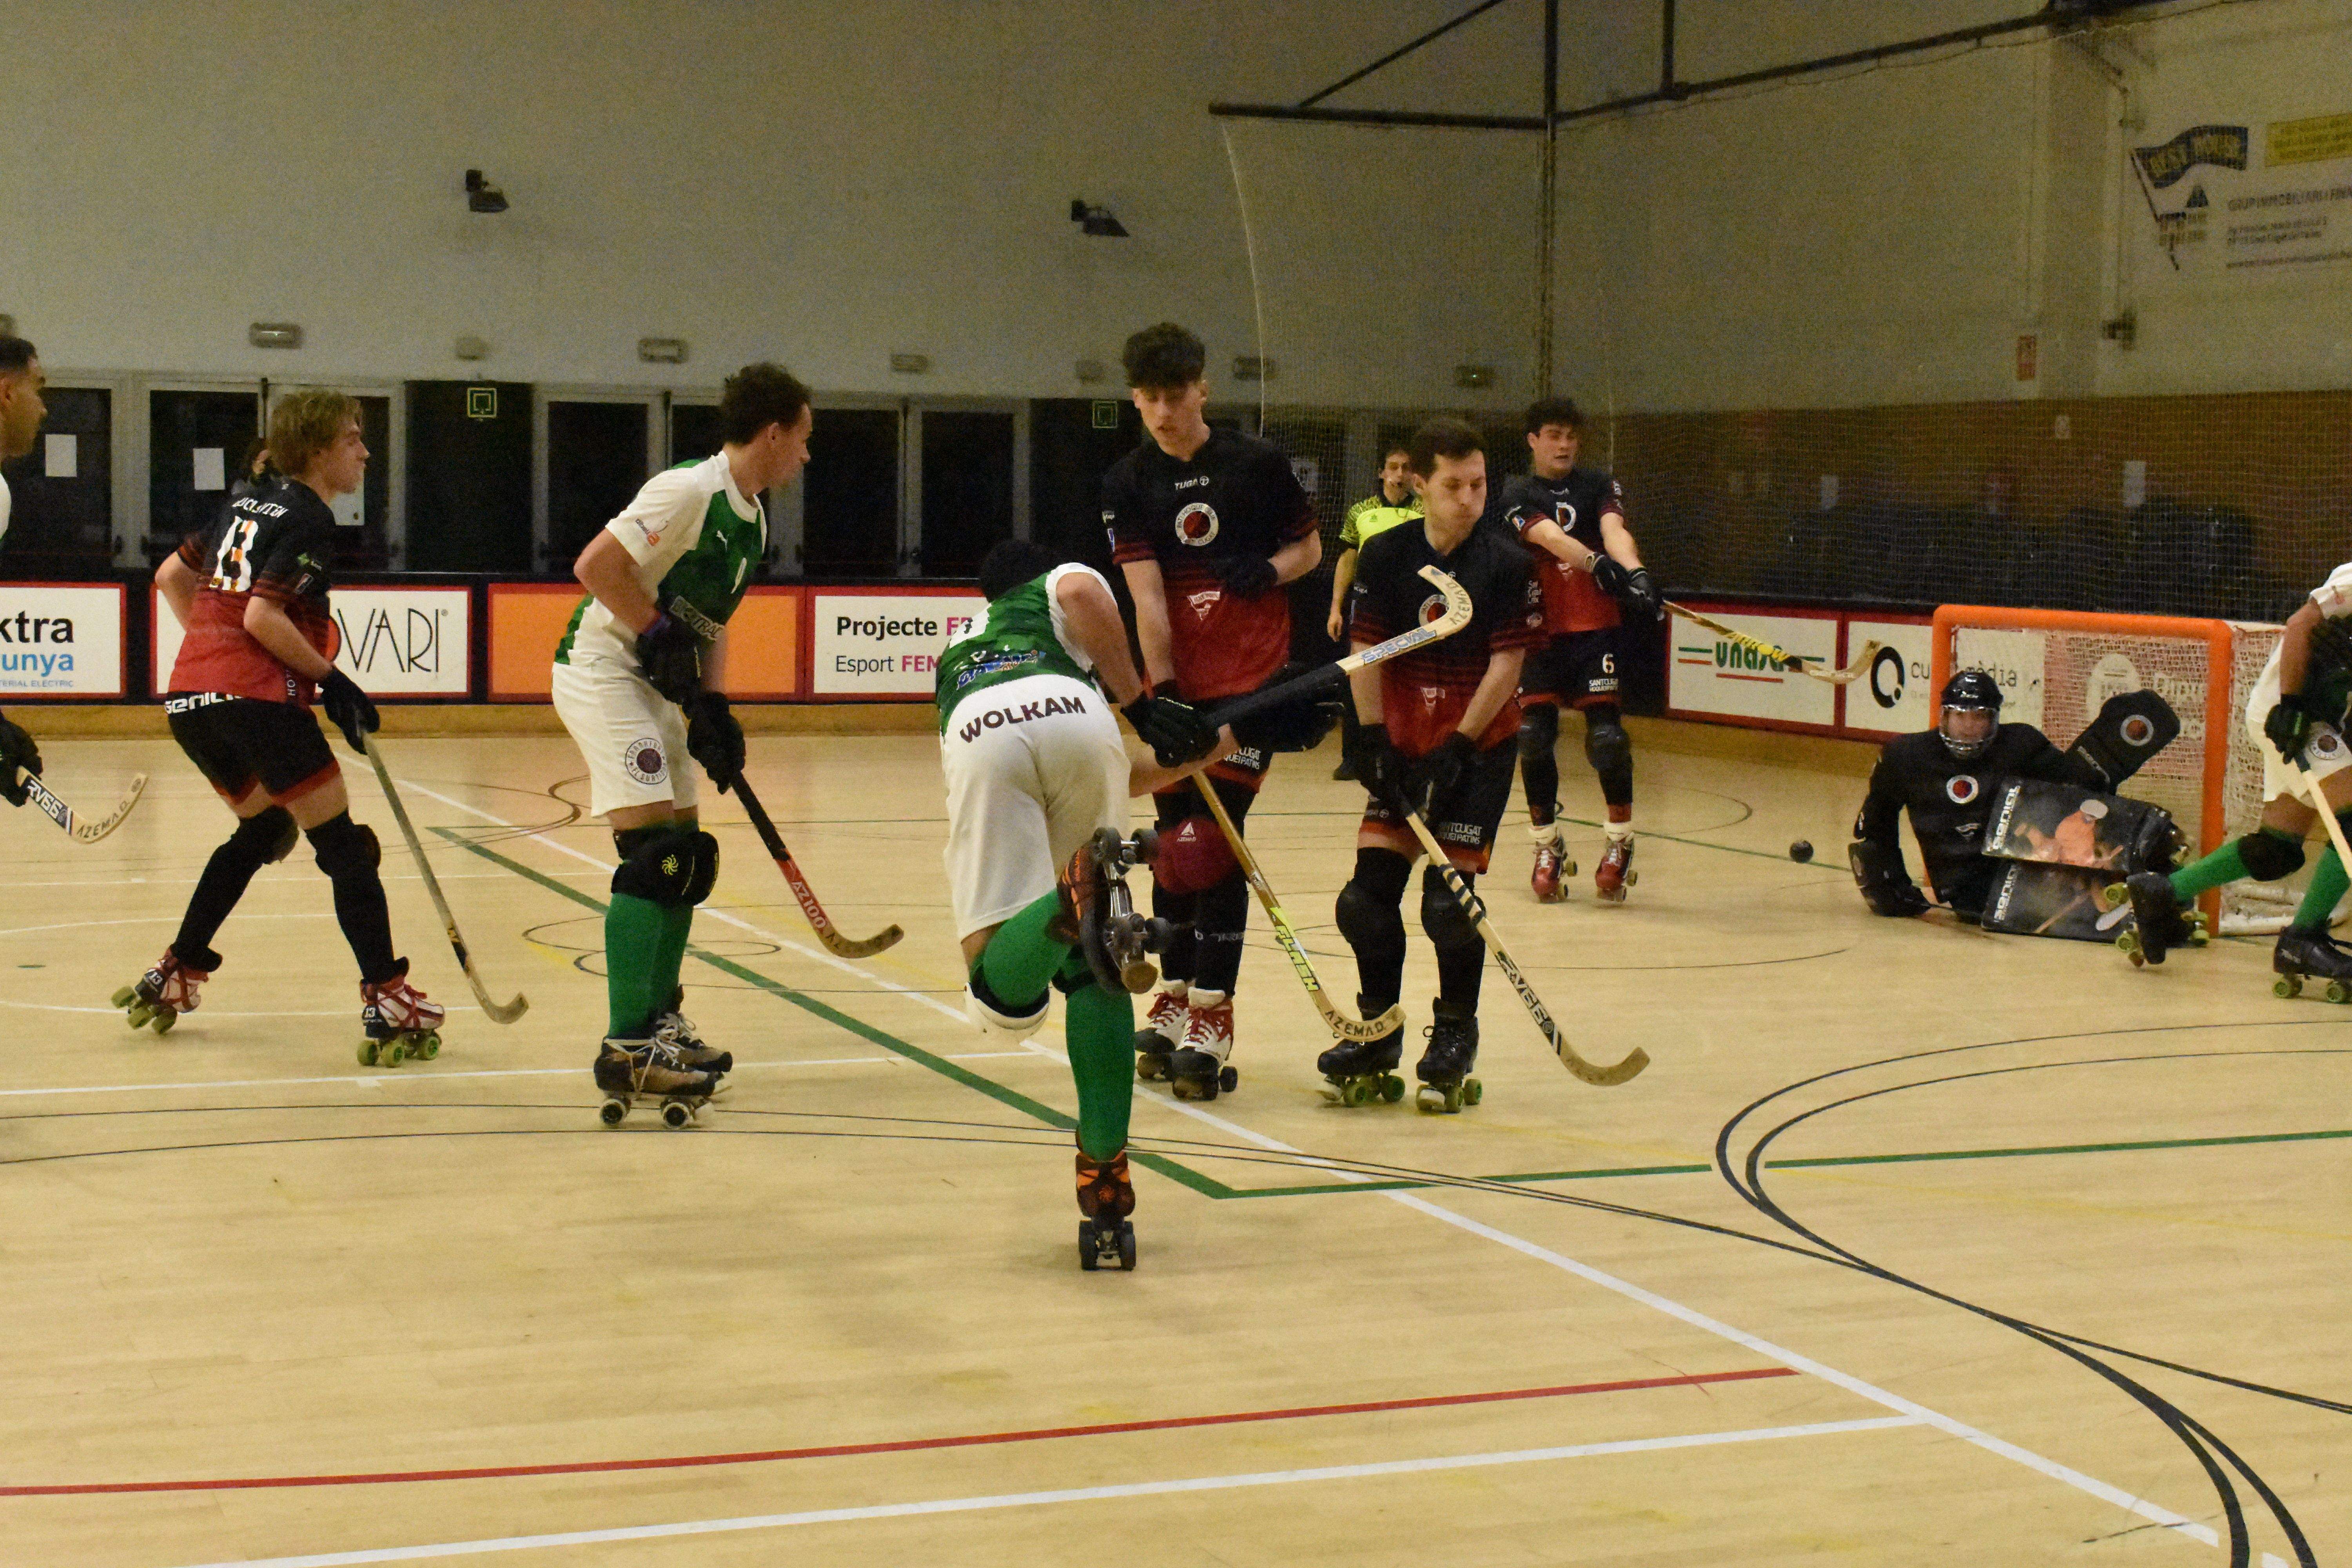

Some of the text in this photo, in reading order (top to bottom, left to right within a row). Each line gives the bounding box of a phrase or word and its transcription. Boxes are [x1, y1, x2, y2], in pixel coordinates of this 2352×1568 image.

[837, 615, 938, 641] Projecte
[1361, 627, 1437, 664] SPECIAL
[836, 655, 894, 676] Esport
[1602, 653, 1614, 674] 6
[960, 696, 1087, 743] WOLKAM
[27, 779, 65, 818] RV66
[1275, 926, 1320, 991] FLASH
[1325, 1010, 1385, 1037] AZEMAD
